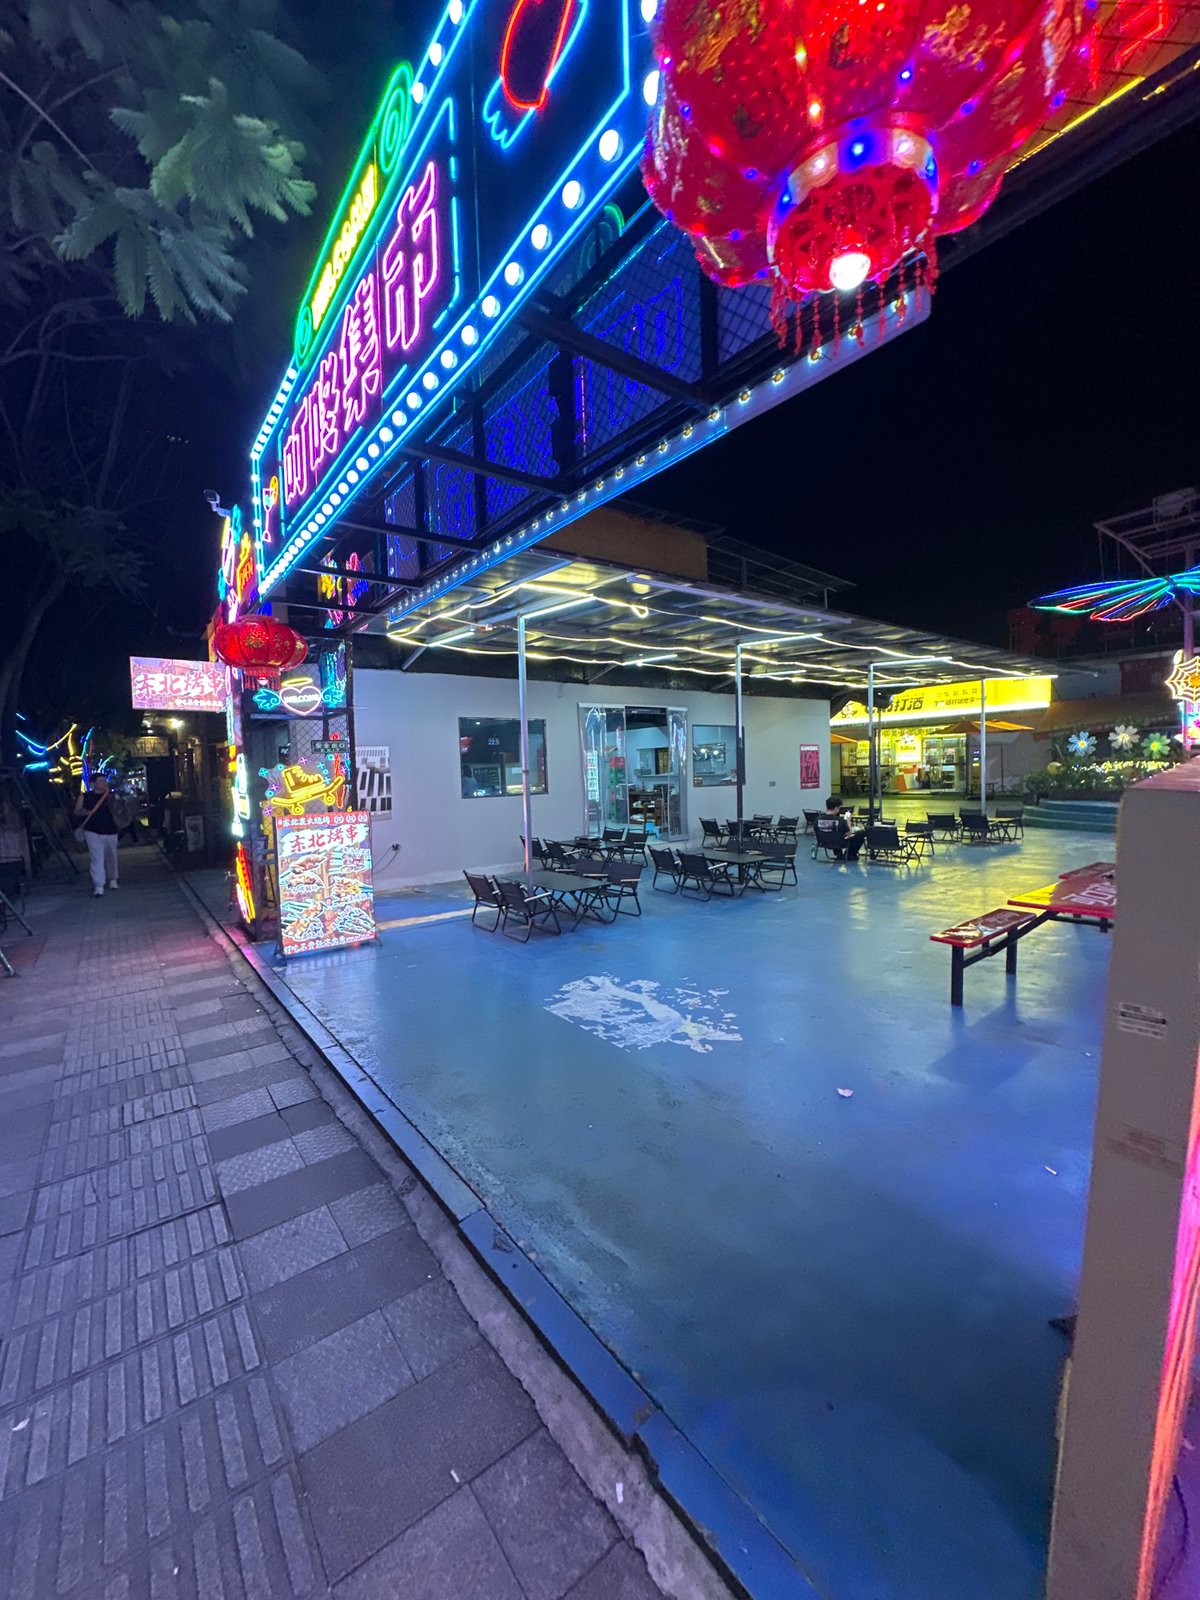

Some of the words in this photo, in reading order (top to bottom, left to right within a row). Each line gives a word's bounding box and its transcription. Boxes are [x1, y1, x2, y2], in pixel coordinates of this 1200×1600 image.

[283, 161, 438, 505] 叮咚集市
[135, 668, 224, 699] 东北烤串
[289, 826, 358, 853] 东北烤串
